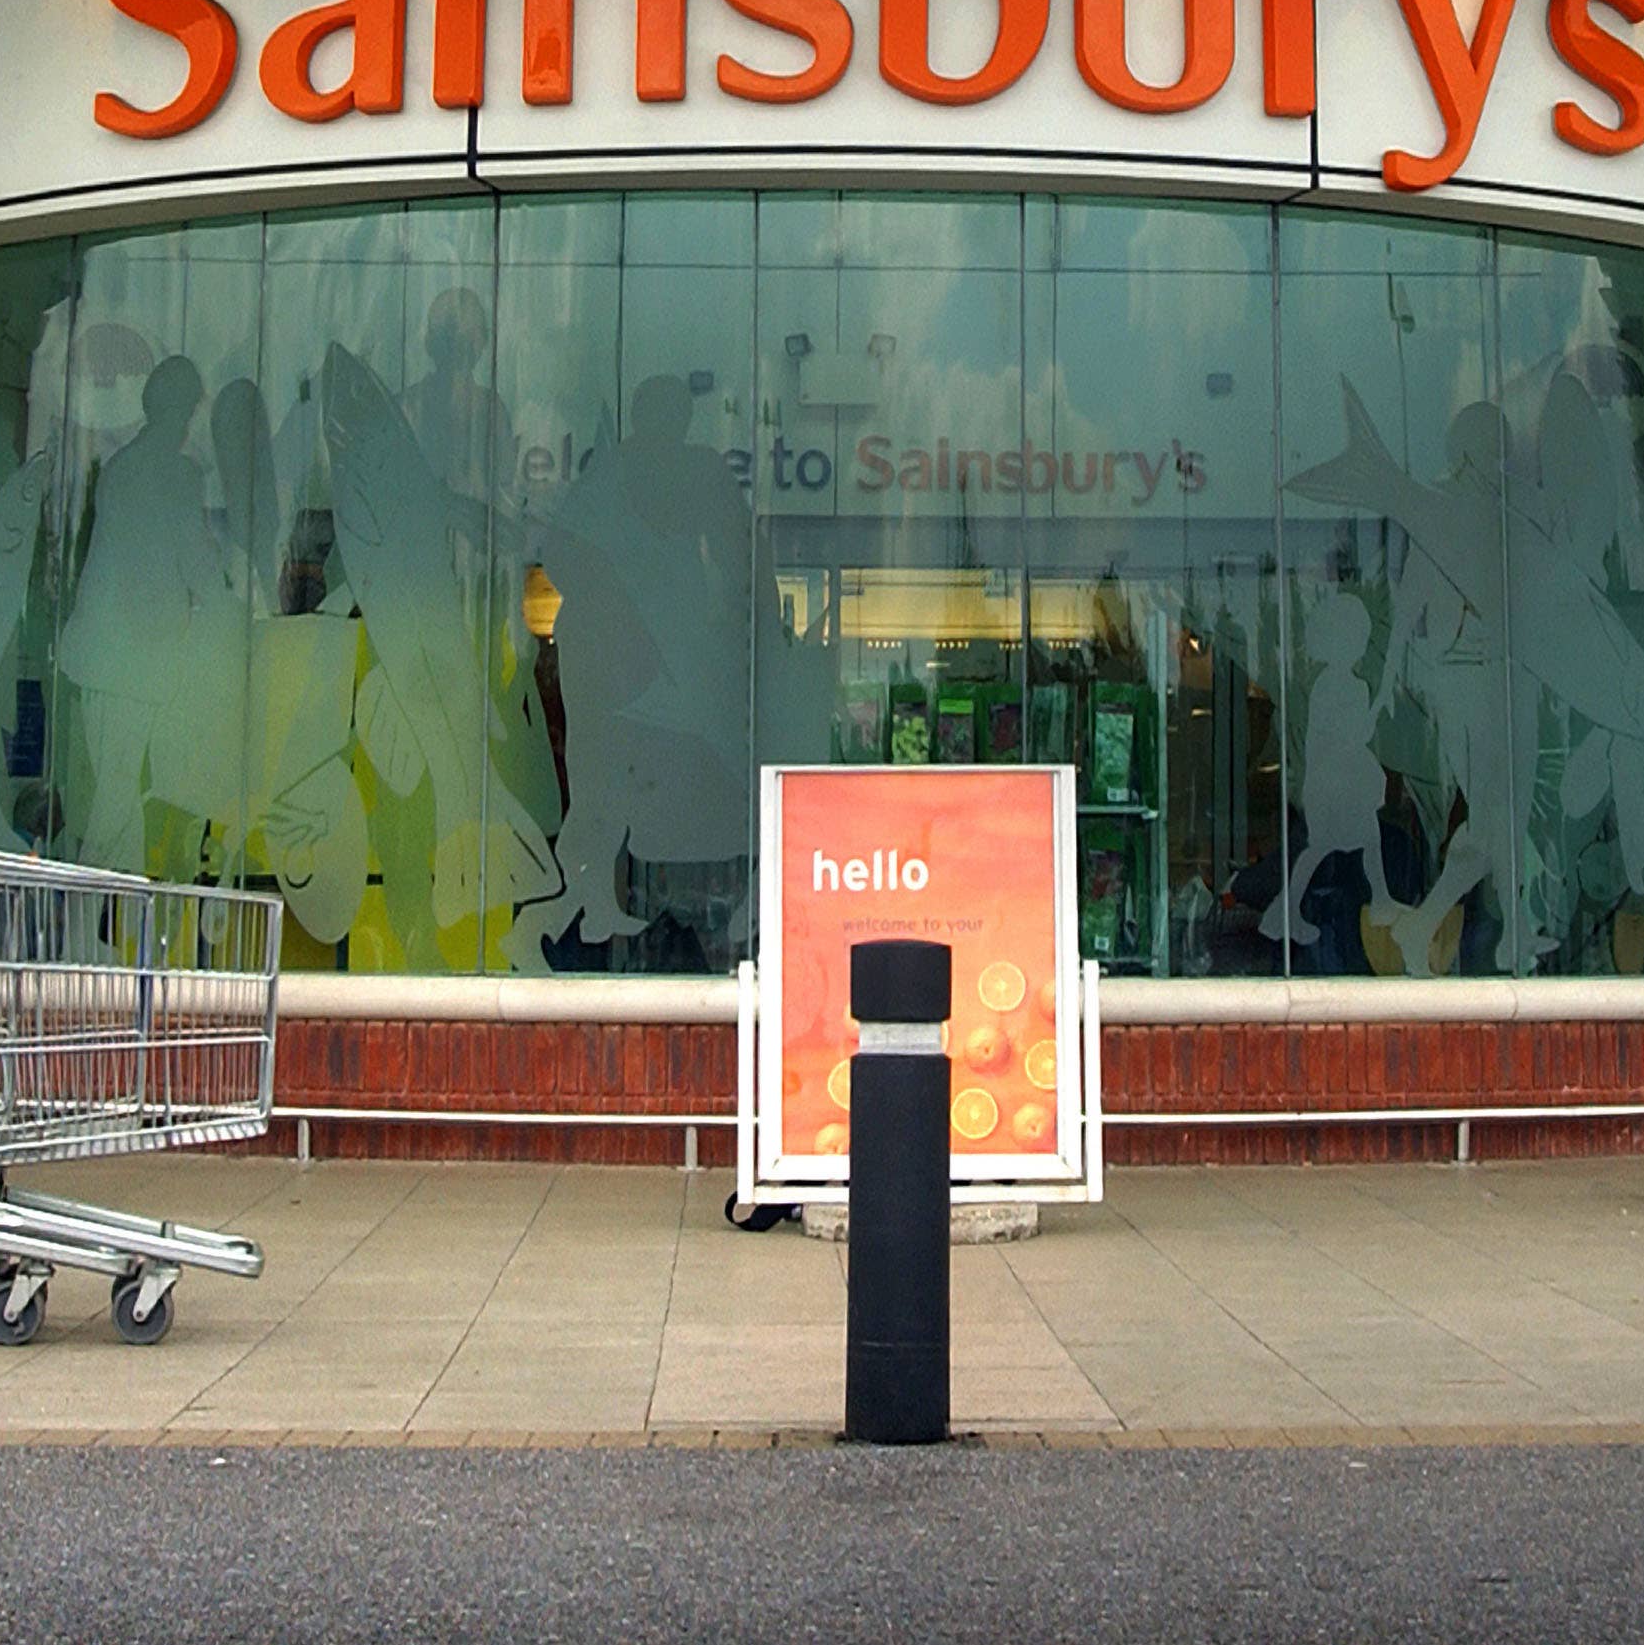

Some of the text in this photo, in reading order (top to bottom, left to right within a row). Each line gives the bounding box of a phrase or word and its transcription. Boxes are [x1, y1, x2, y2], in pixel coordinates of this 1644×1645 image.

[771, 435, 833, 492] to
[855, 435, 1207, 504] Sainsbury's
[813, 848, 929, 891] hello
[843, 917, 984, 935] welcome to your
